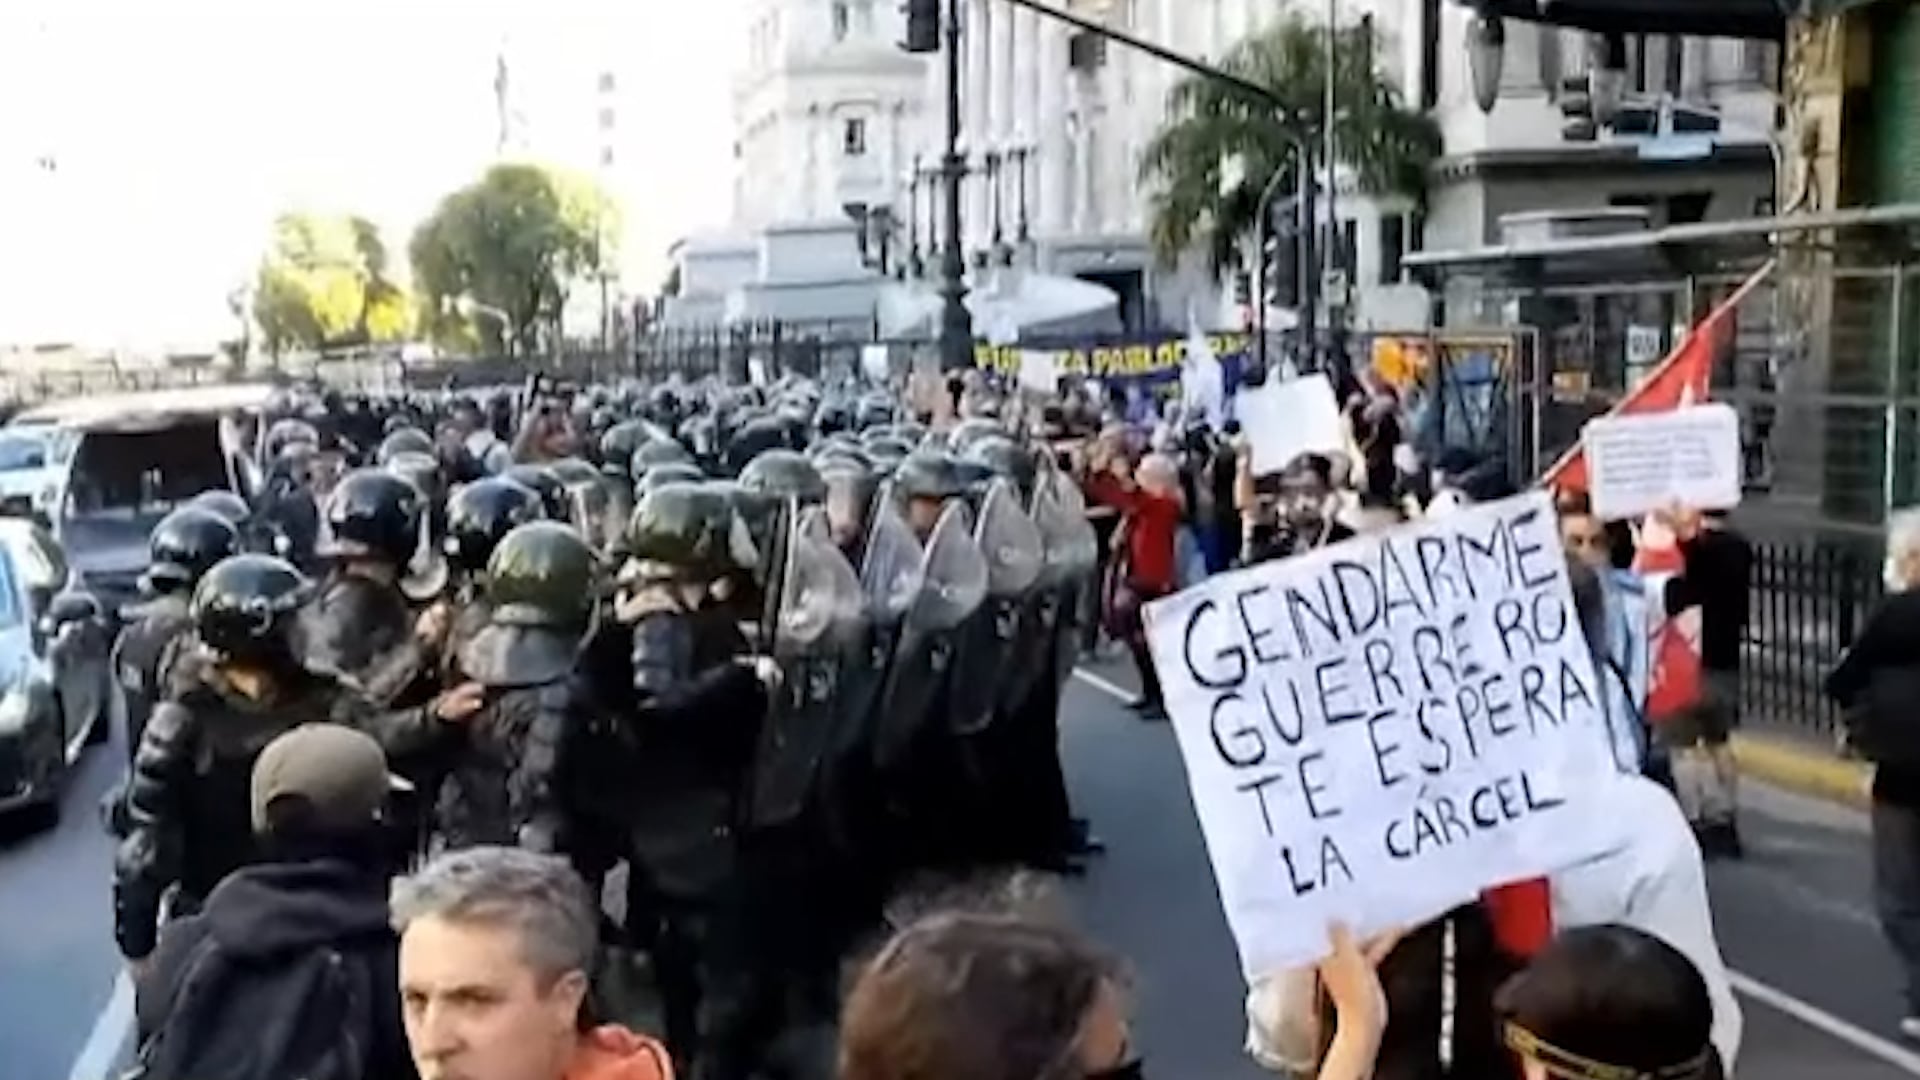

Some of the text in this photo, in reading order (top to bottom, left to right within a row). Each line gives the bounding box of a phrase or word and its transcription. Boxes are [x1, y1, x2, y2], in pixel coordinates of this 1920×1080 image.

[1184, 511, 1557, 688] GENDARME
[1237, 658, 1594, 836] TE ESPERA
[1281, 770, 1566, 896] LA CÁRCEL
